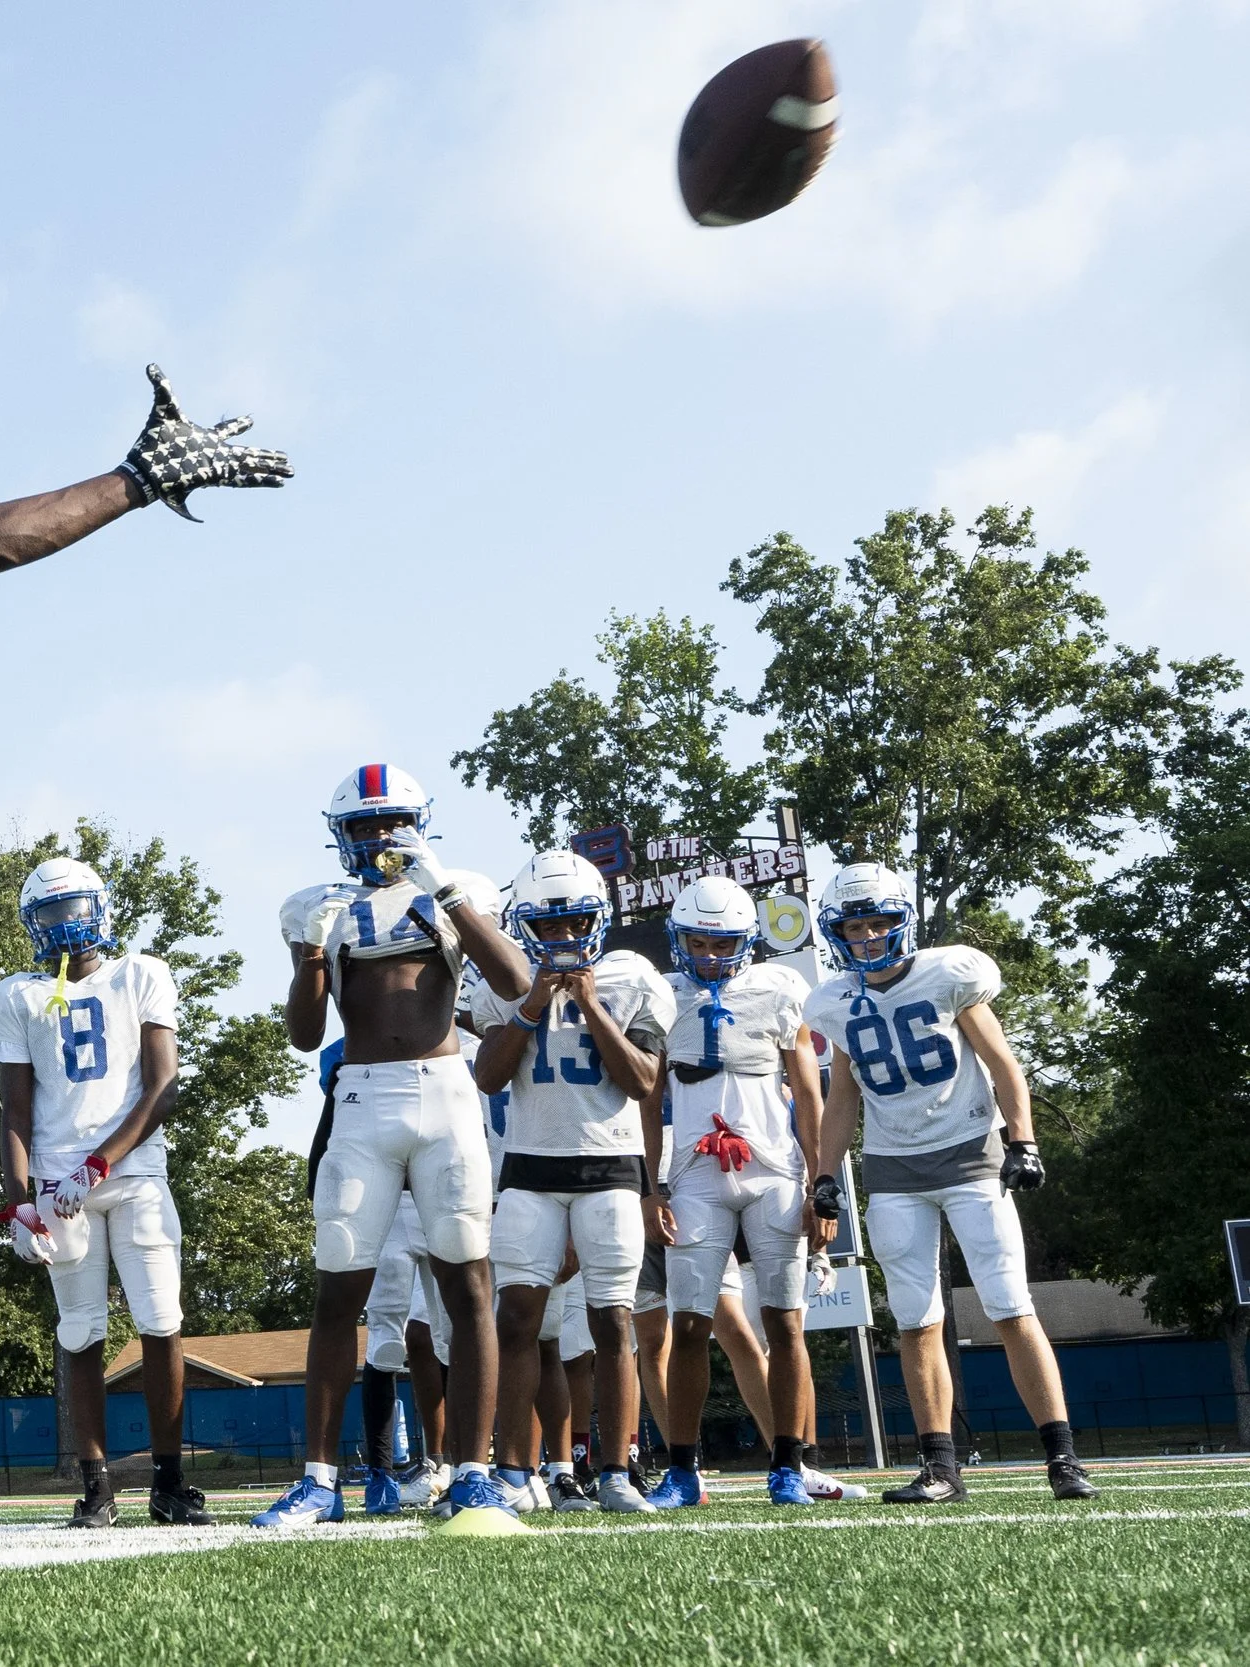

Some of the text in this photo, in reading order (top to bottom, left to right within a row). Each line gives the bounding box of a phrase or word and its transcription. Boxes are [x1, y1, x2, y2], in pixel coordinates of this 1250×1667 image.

[617, 845, 801, 912] PANTHERS
[647, 837, 700, 861] OF THE
[350, 893, 436, 947] 14
[58, 996, 108, 1083] 8
[532, 1000, 611, 1086] 13
[698, 1004, 724, 1070] 1
[845, 1000, 957, 1096] 86
